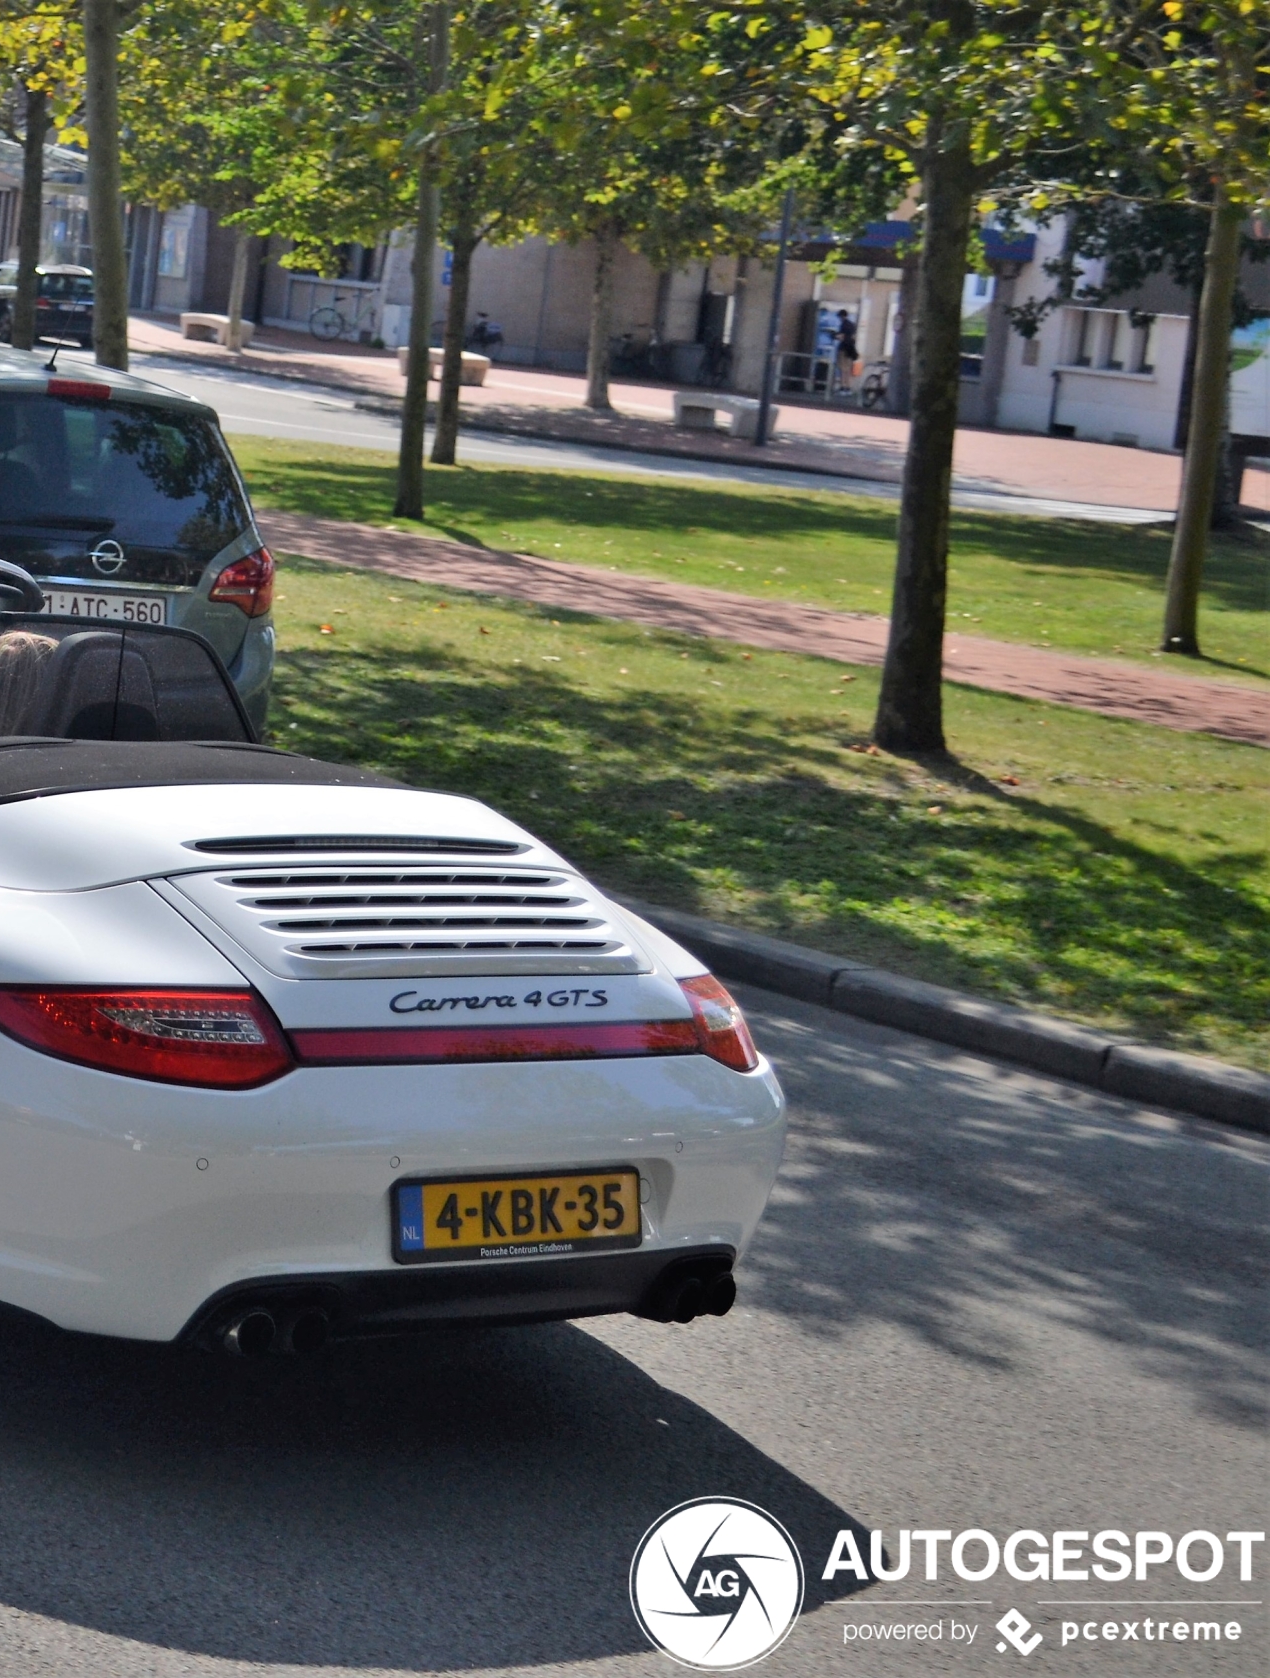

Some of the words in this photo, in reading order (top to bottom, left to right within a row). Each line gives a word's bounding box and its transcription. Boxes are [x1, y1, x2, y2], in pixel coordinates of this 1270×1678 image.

[389, 991, 518, 1013] Carrera
[436, 1183, 625, 1240] 4-KBK-35
[402, 1225, 420, 1241] NL
[480, 1246, 508, 1257] Porsche
[509, 1245, 538, 1256] Centrum
[539, 1242, 573, 1253] Eindhoven
